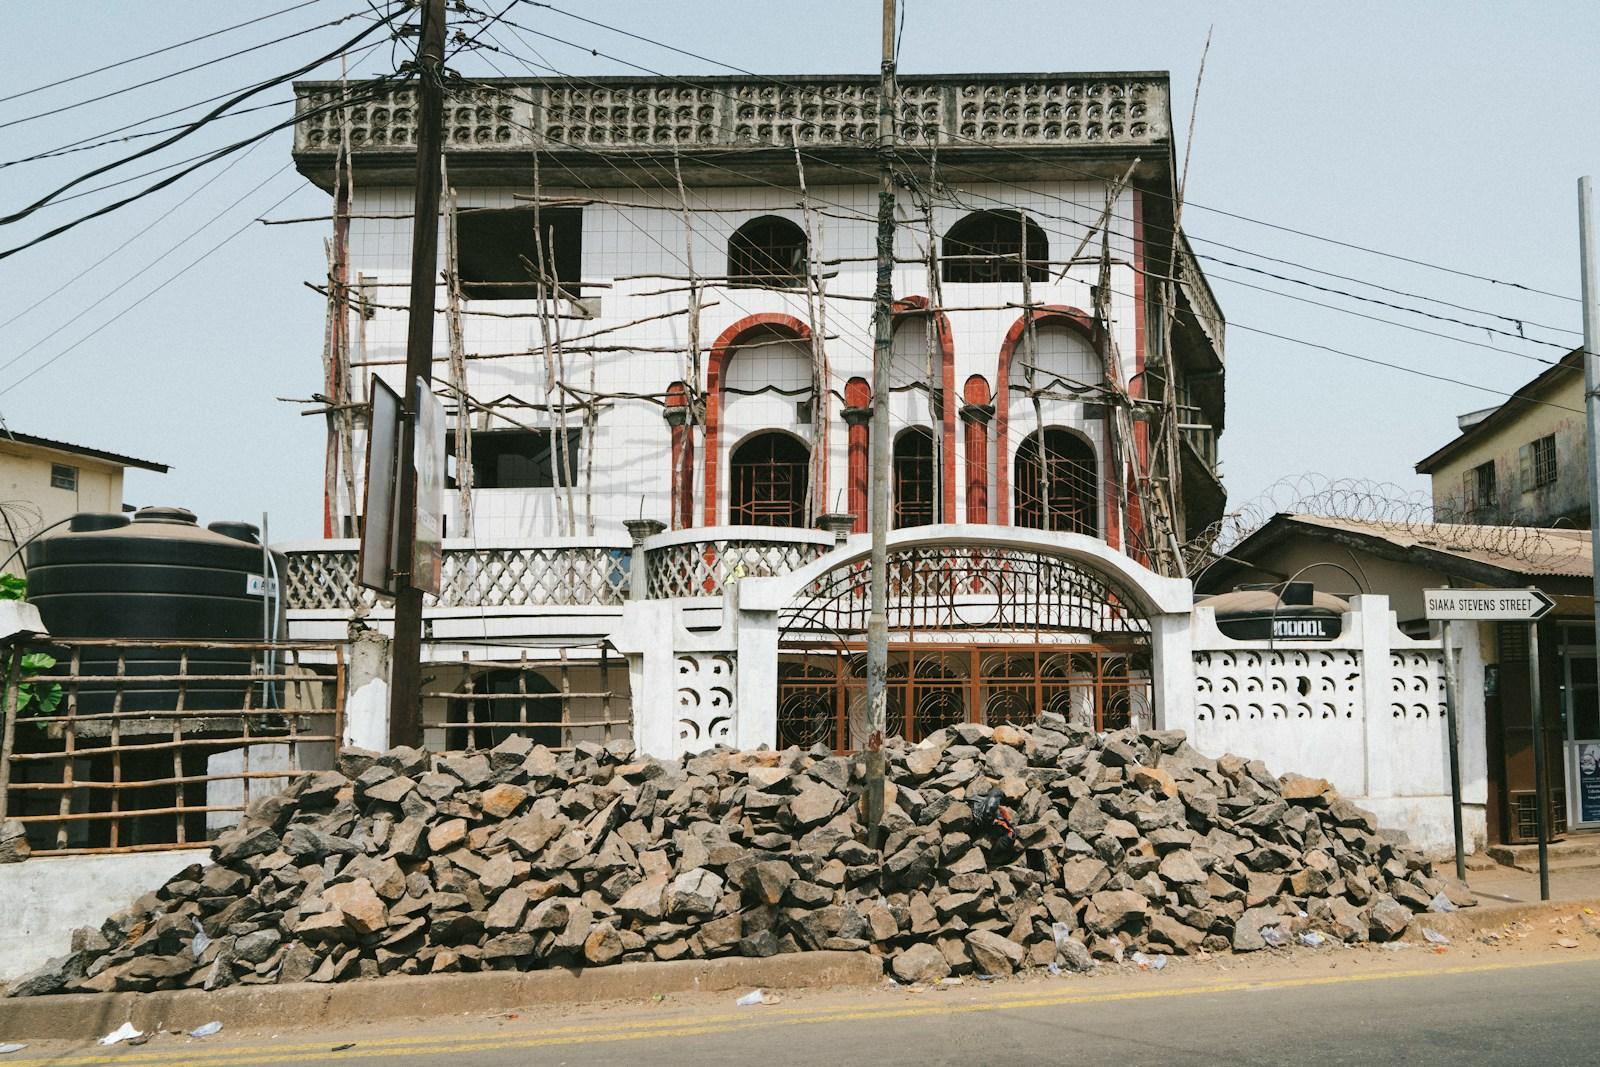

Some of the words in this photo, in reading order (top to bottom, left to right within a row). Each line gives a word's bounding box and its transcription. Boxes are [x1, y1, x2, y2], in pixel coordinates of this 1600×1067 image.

[1429, 599, 1455, 611] SIAKA
[1459, 599, 1496, 611] STEVENS
[1499, 599, 1532, 611] STREET
